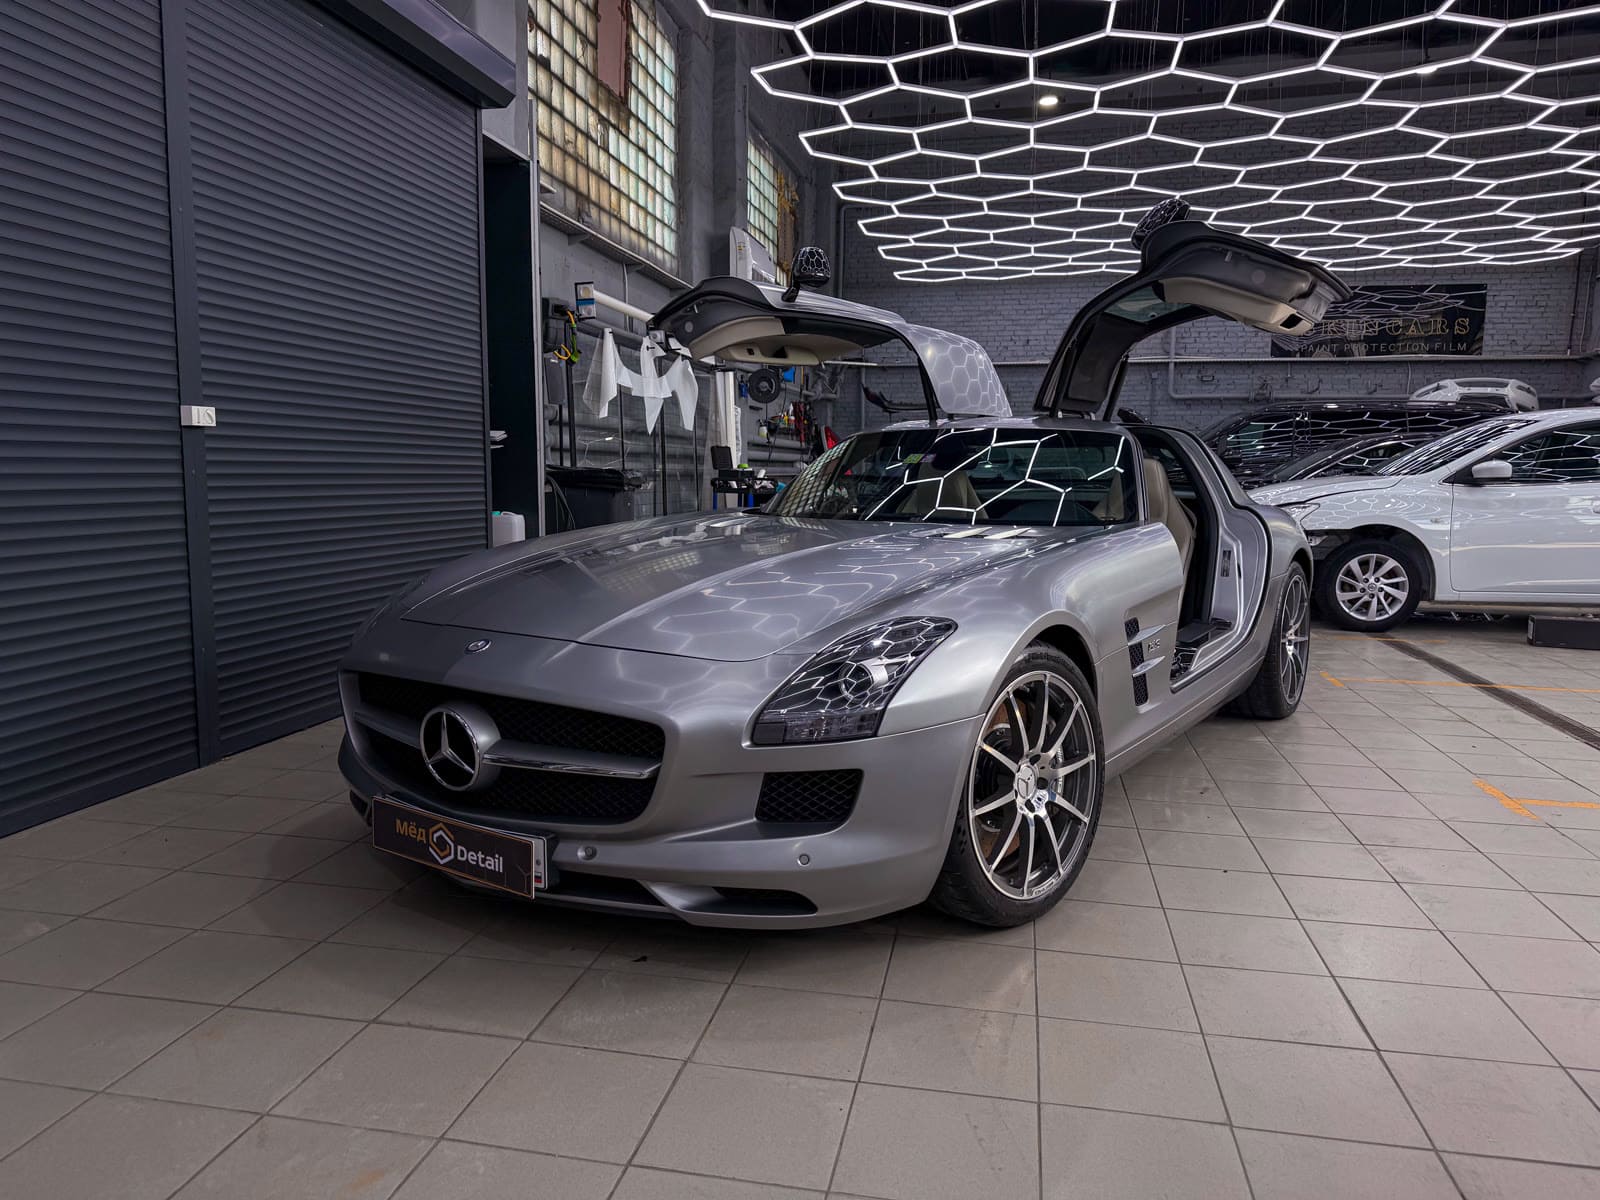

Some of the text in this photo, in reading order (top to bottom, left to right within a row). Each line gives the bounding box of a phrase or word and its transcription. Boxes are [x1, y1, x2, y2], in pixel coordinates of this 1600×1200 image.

[1301, 342, 1467, 352] PAINT PROTECTION FILM
[395, 818, 427, 844] Мёд
[456, 845, 504, 873] Detail
